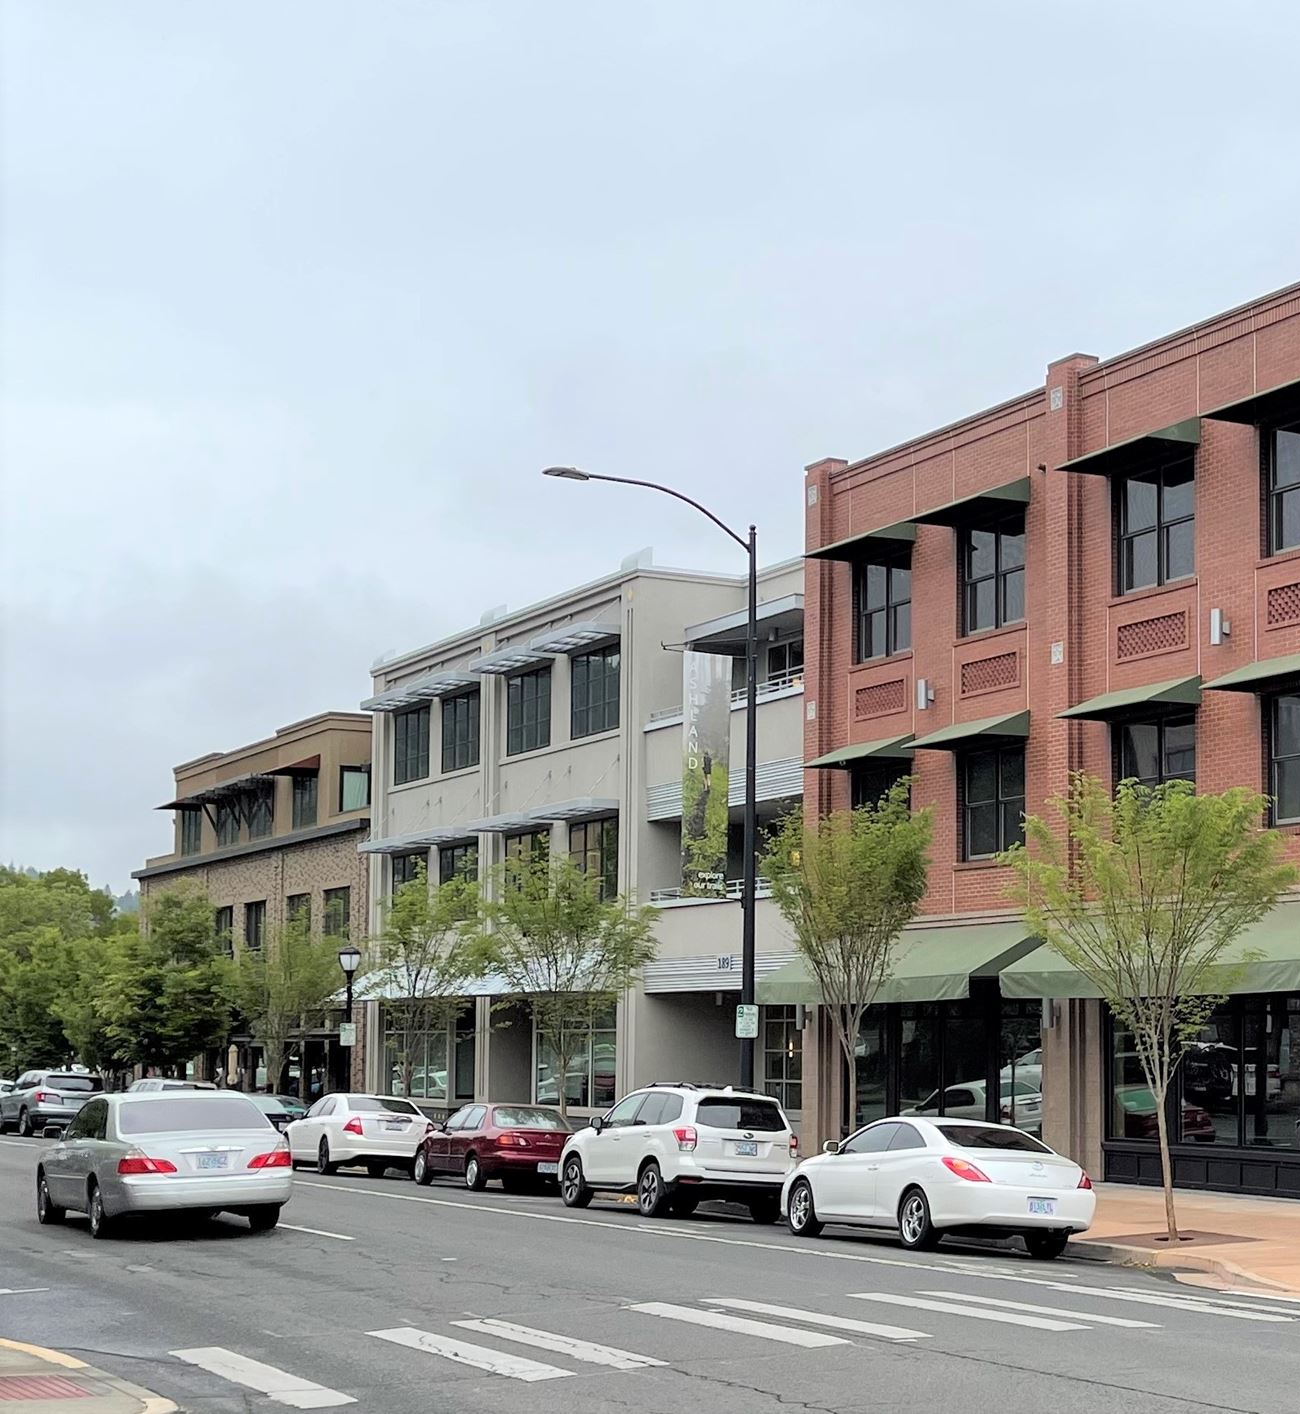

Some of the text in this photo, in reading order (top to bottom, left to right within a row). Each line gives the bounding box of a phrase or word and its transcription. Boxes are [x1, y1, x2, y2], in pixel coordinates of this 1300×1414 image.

[688, 661, 699, 770] ASHLAND
[697, 871, 725, 881] explore
[693, 881, 706, 889] our
[718, 957, 730, 969] 189
